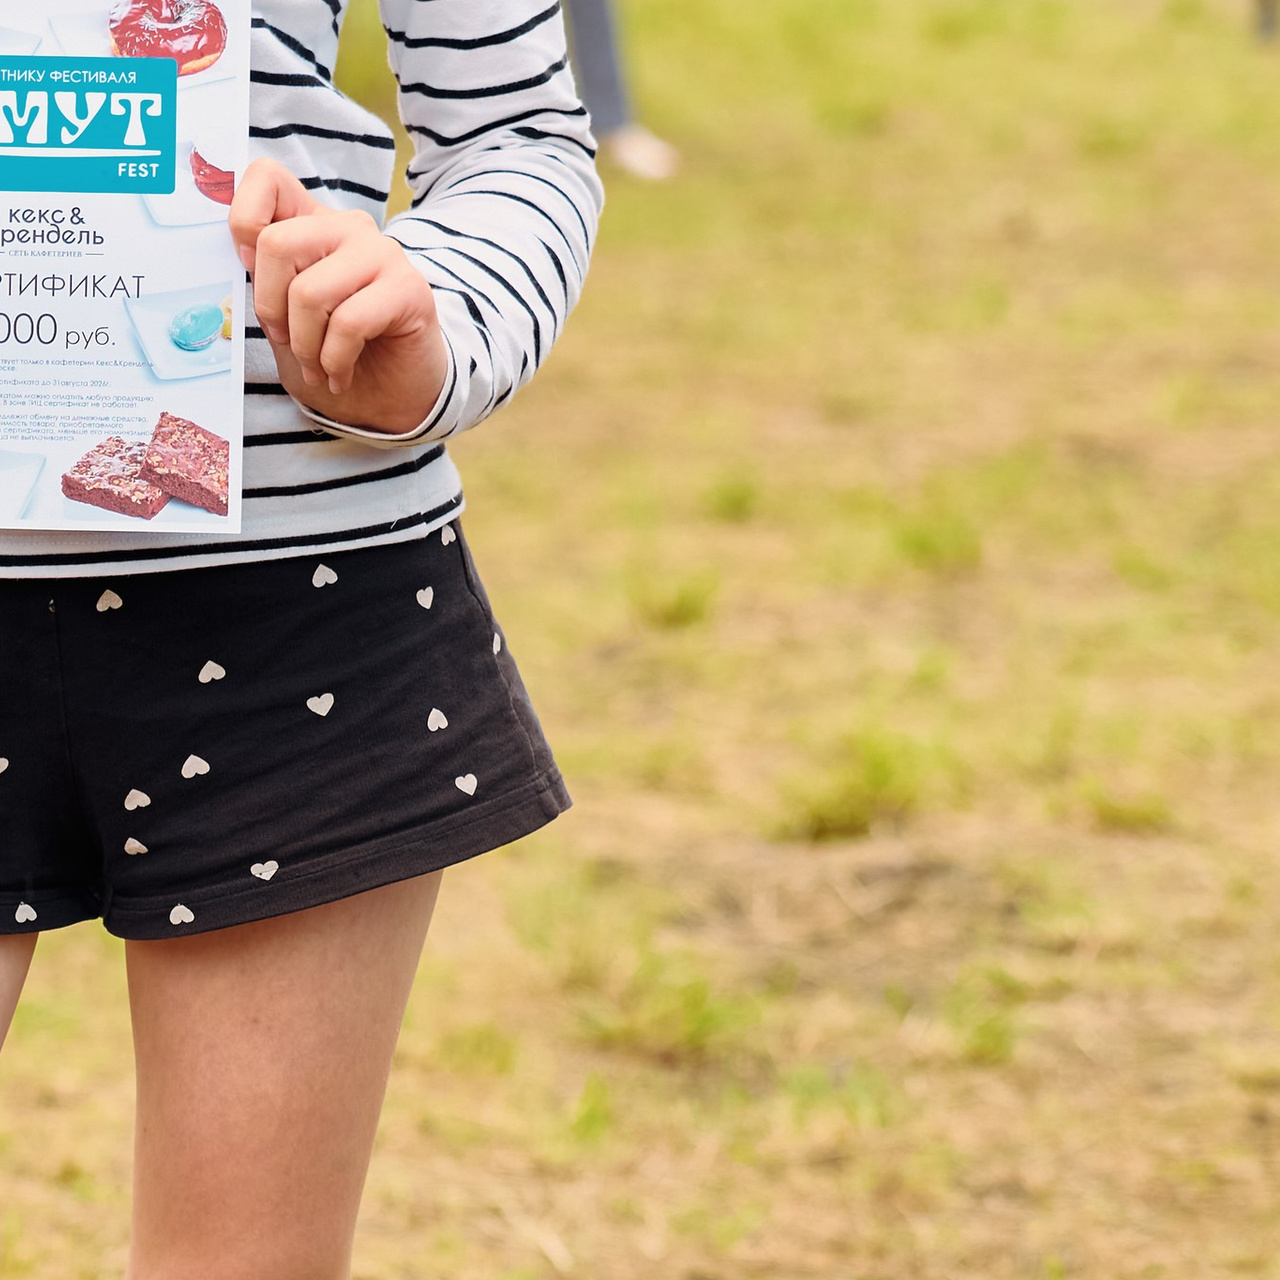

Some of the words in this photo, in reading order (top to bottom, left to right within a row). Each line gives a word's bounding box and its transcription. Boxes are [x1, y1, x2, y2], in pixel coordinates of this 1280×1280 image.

[49, 70, 137, 84] ФЕСТИВАЛЯ
[118, 163, 160, 177] FEST
[9, 208, 65, 224] кекс
[70, 206, 86, 225] &
[8, 249, 29, 257] СЕТЬ
[30, 250, 82, 258] КАФЕТЕРИЕВ
[65, 326, 116, 350] руб.
[51, 359, 94, 367] кафетерии
[29, 413, 59, 421] обмену
[58, 421, 124, 429] приобретаемого
